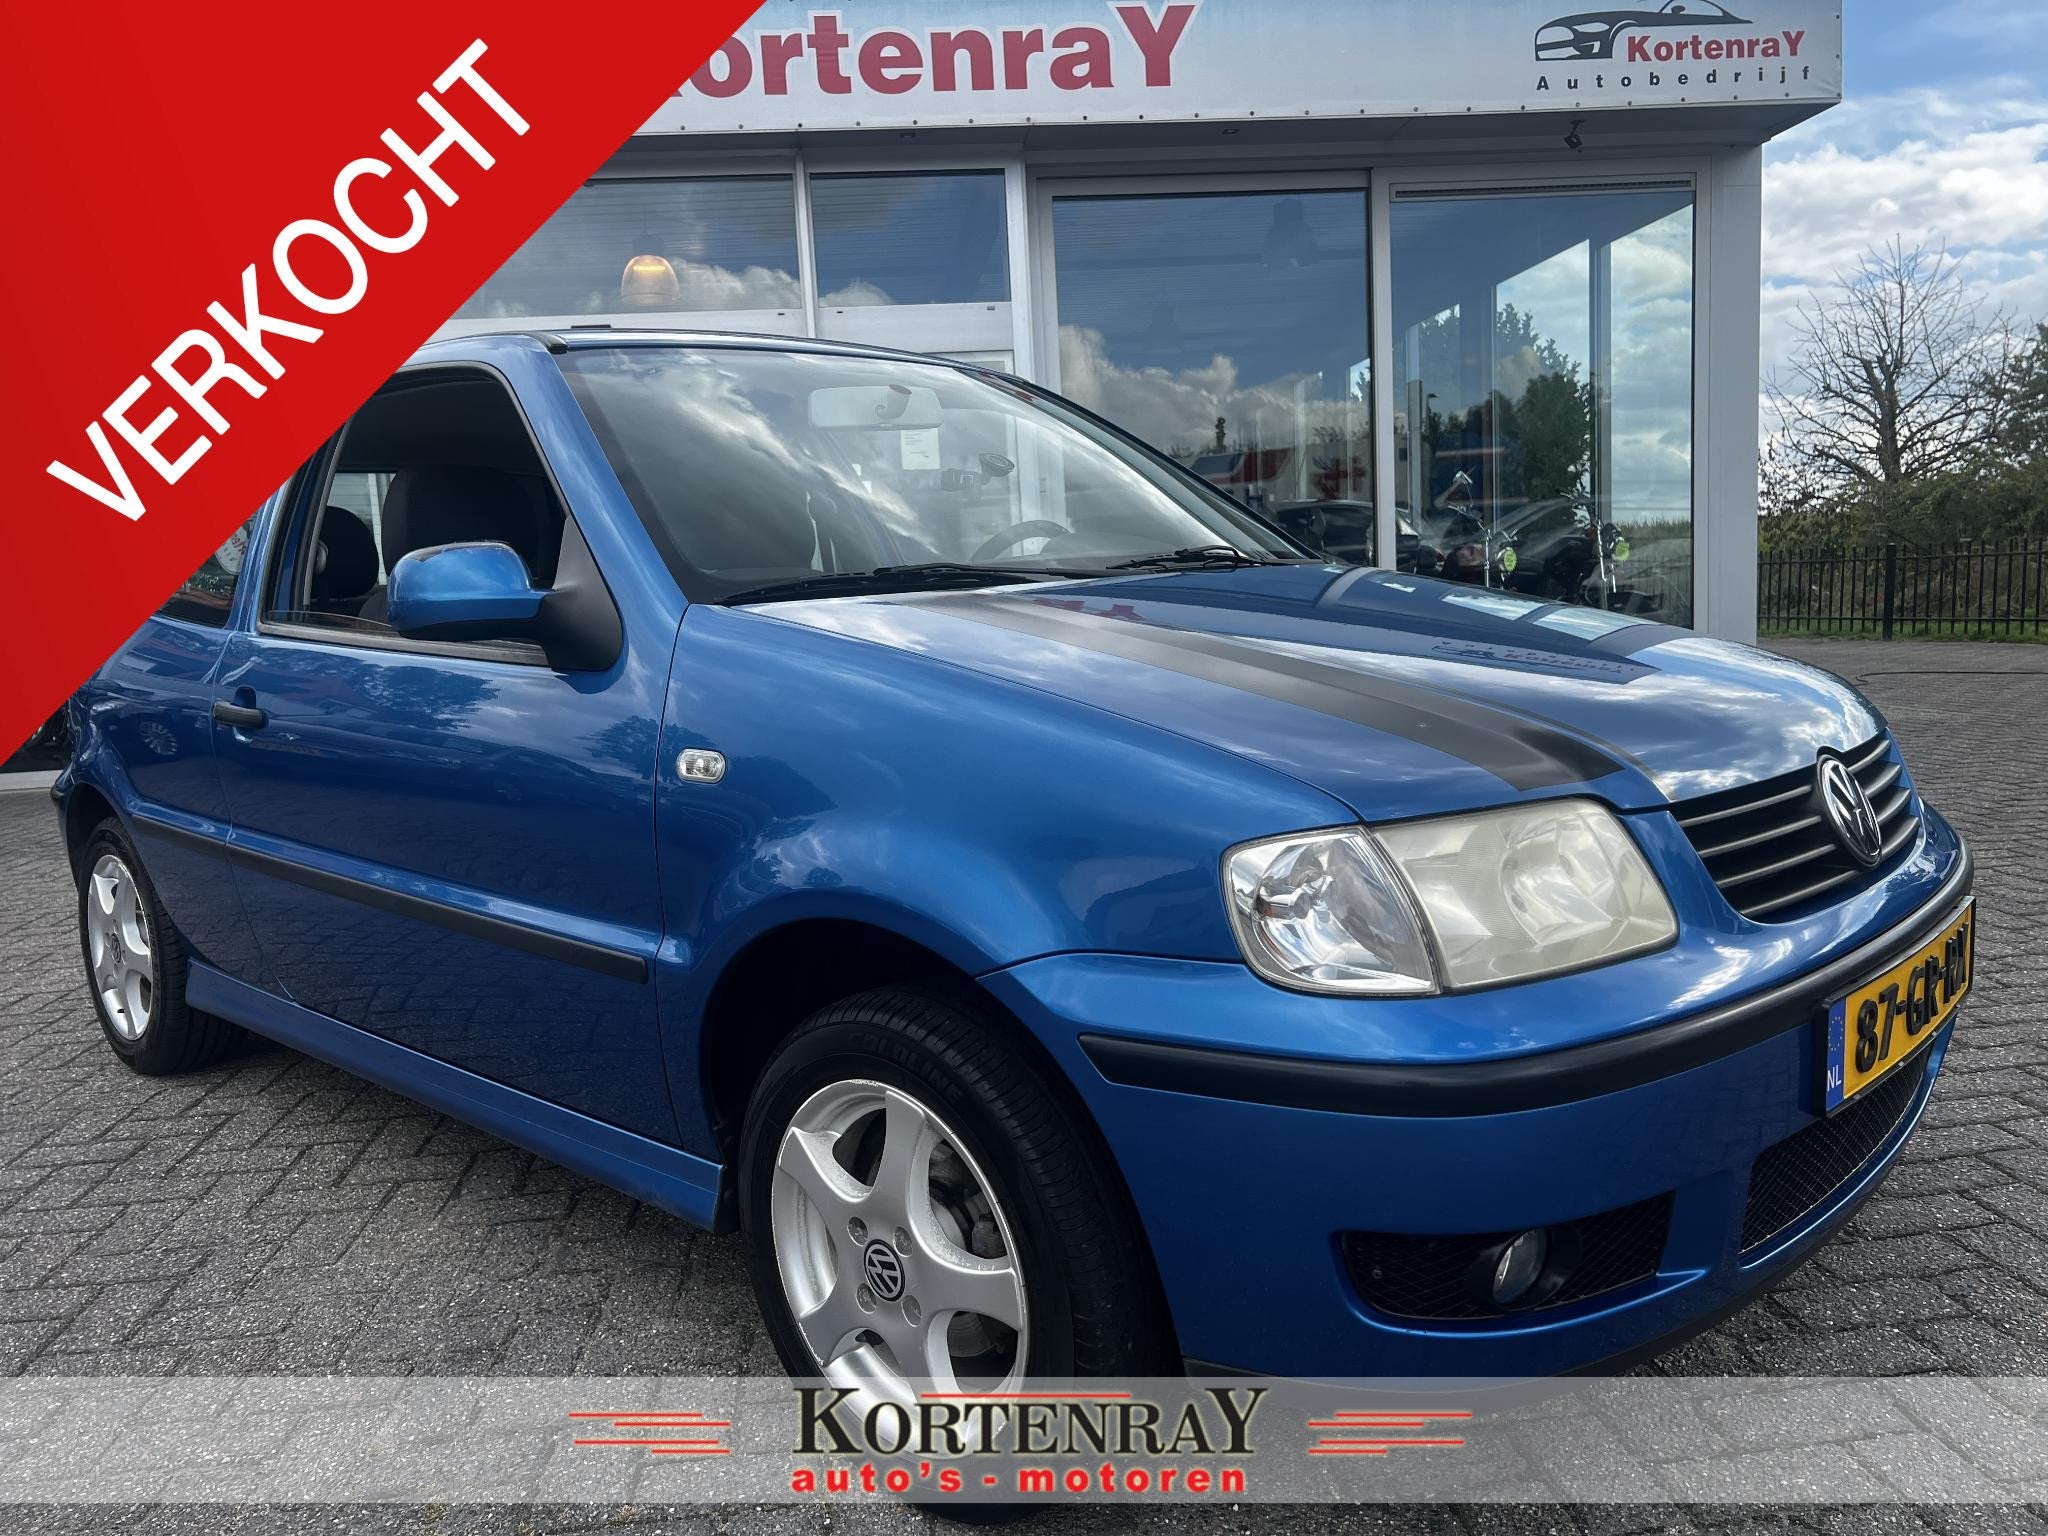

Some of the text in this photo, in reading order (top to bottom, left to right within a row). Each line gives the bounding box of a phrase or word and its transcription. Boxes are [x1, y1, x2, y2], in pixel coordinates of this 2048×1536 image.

[669, 3, 1196, 98] ortenraY
[1627, 31, 1806, 62] KortenraY
[1827, 1064, 1842, 1092] NL
